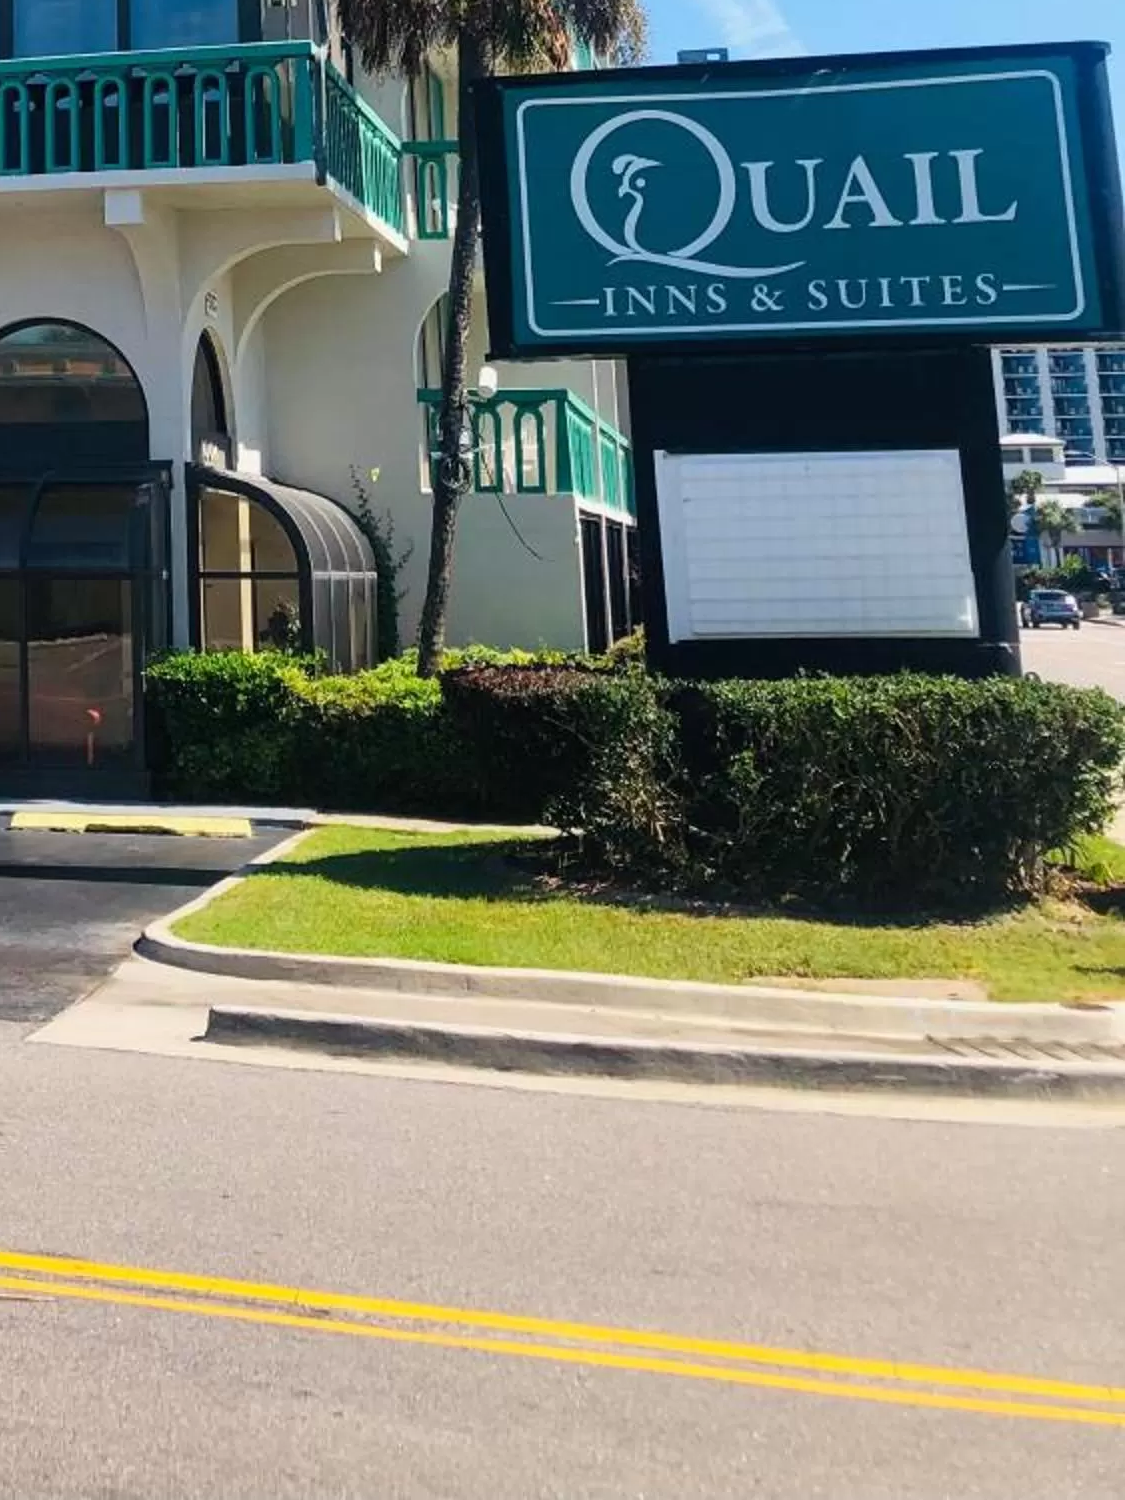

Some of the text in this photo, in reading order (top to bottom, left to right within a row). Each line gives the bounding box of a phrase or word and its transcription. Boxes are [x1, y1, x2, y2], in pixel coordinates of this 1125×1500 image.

[570, 109, 1018, 277] QUAIL
[603, 273, 998, 317] INNS & SUITES
